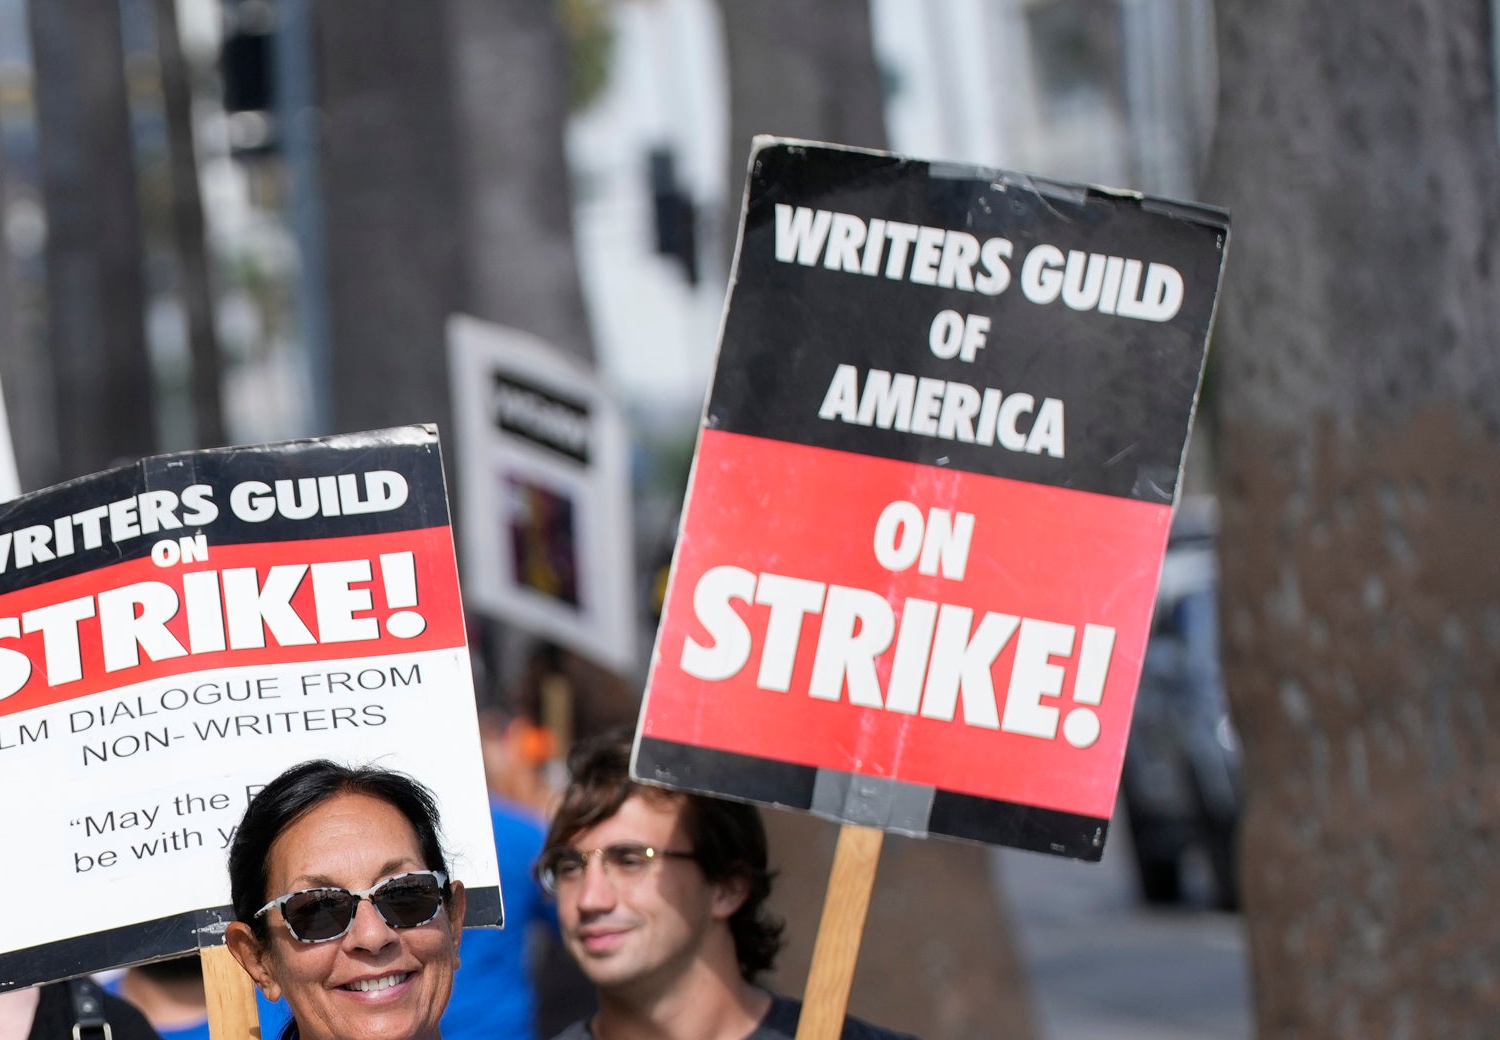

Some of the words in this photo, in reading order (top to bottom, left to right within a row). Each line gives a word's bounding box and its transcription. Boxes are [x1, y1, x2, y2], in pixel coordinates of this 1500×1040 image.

[774, 203, 1013, 296] WRITERS
[1021, 244, 1184, 323] GUILD
[929, 310, 991, 363] OF
[818, 364, 1065, 459] AMERICA
[230, 470, 409, 522] GUILD
[151, 535, 208, 568] ON
[873, 500, 976, 581] ON
[679, 565, 1116, 749] STRIKE!
[70, 676, 281, 734] DIALOGUE
[301, 664, 423, 698] FROM
[174, 792, 230, 817] the
[74, 850, 118, 873] be
[131, 826, 203, 861] with
